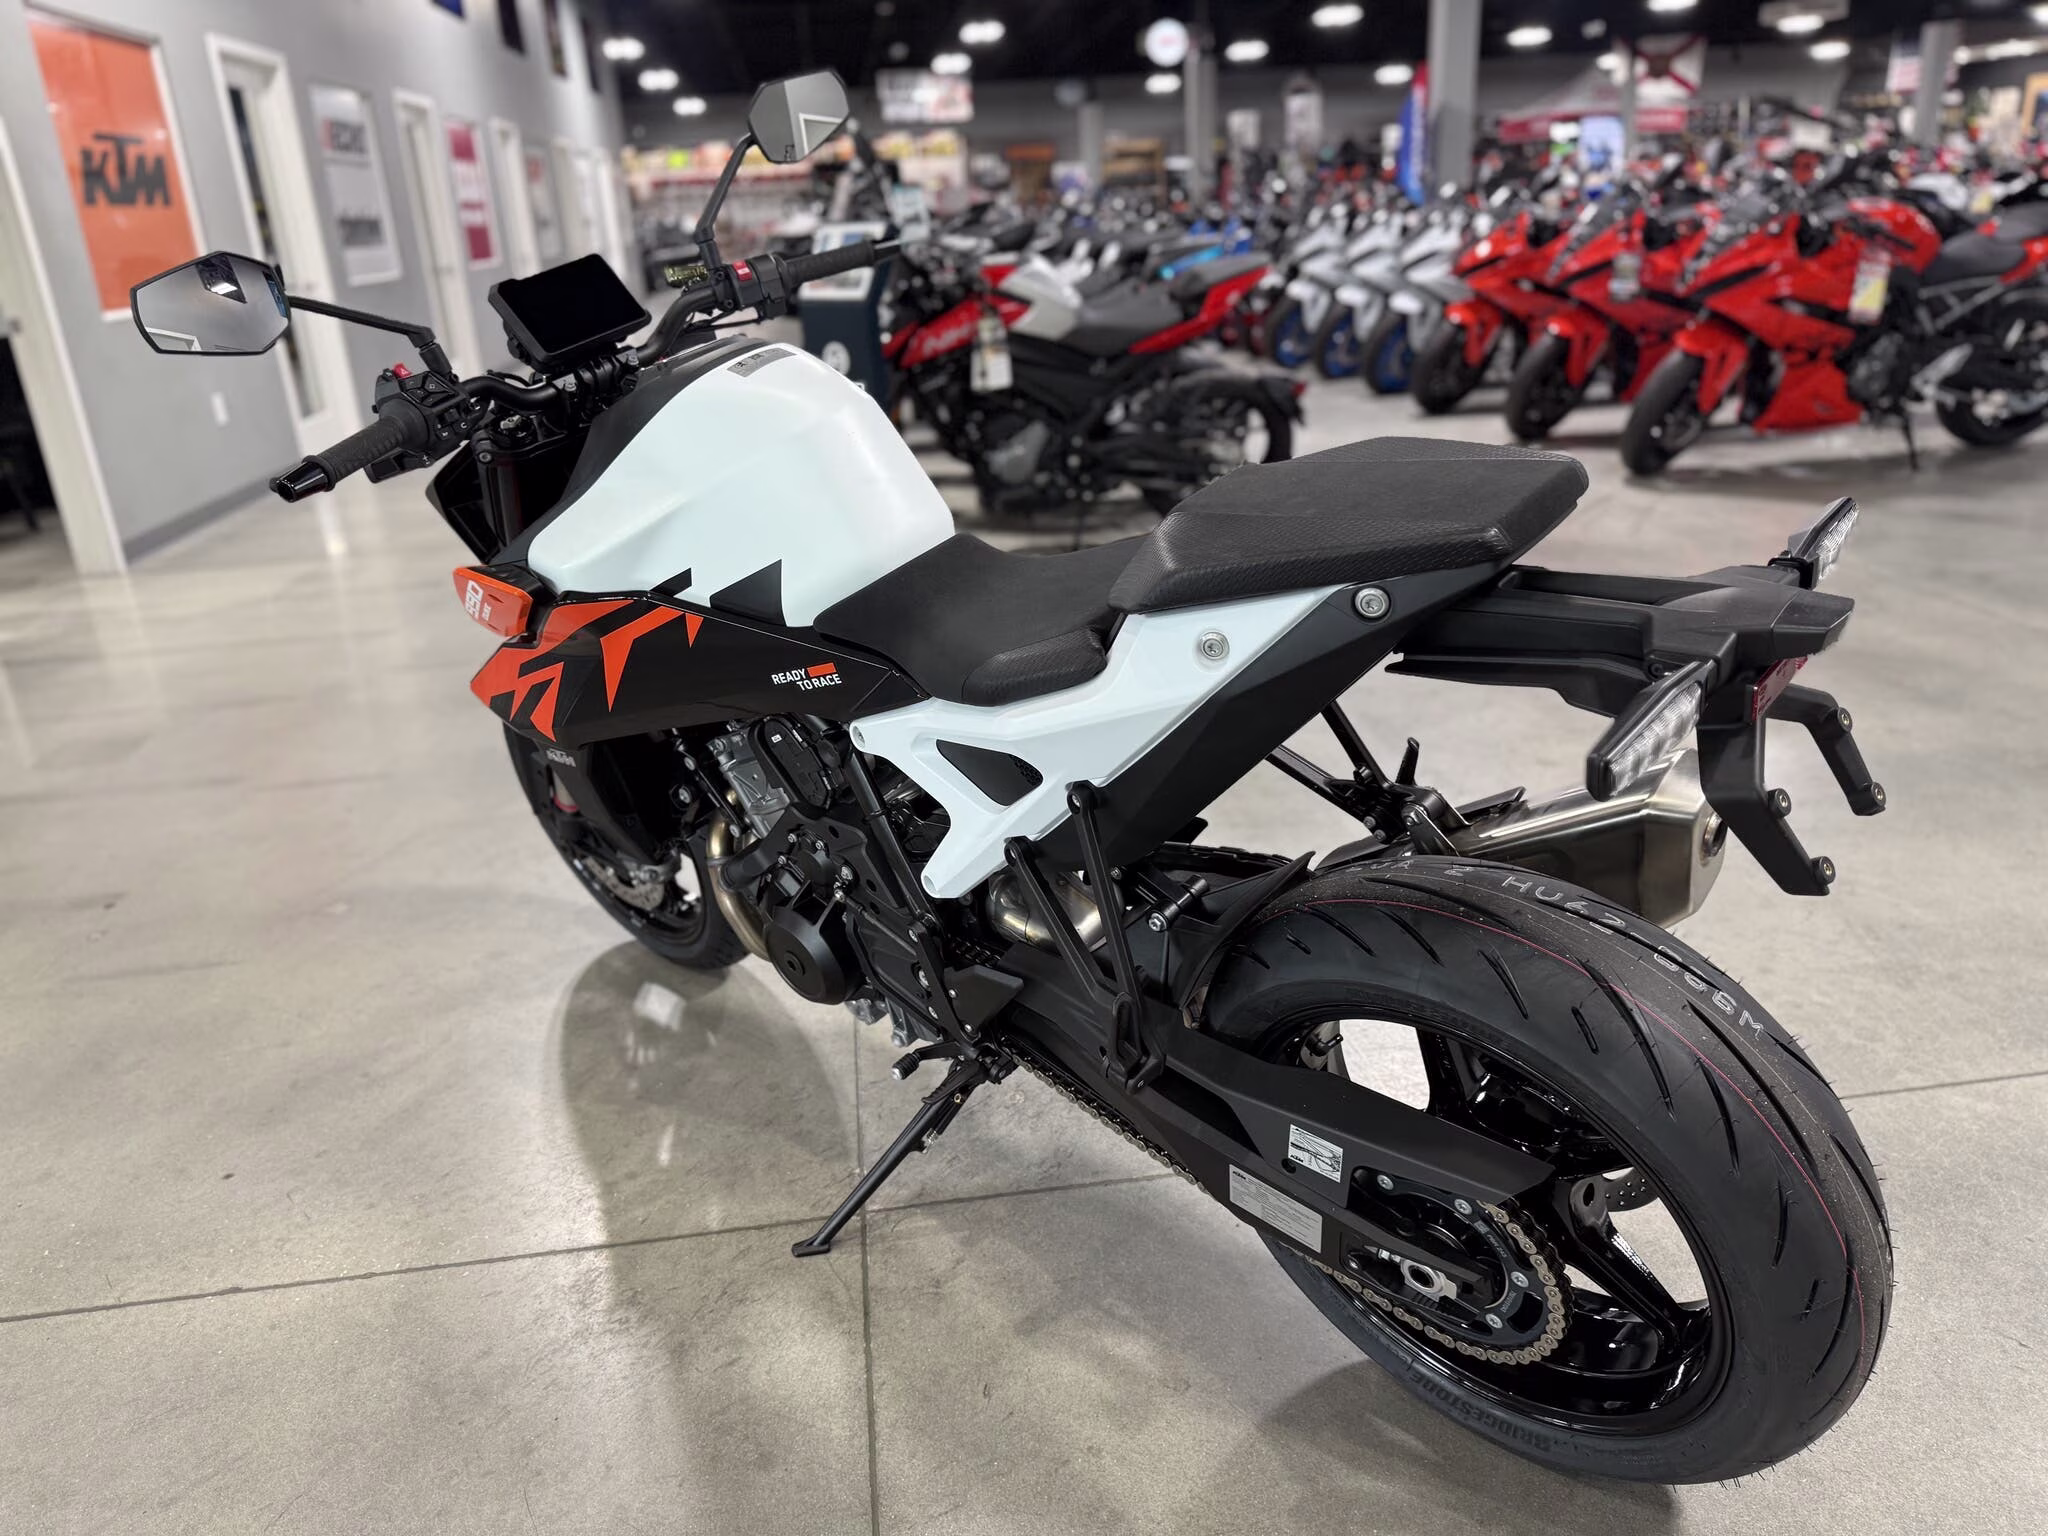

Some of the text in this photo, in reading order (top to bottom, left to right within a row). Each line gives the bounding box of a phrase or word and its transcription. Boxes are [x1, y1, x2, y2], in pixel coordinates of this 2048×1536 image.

[81, 133, 171, 206] KTM
[771, 668, 806, 685] READY
[796, 674, 842, 691] TO RACE
[1410, 1371, 1551, 1450] BRIDGESTONE
